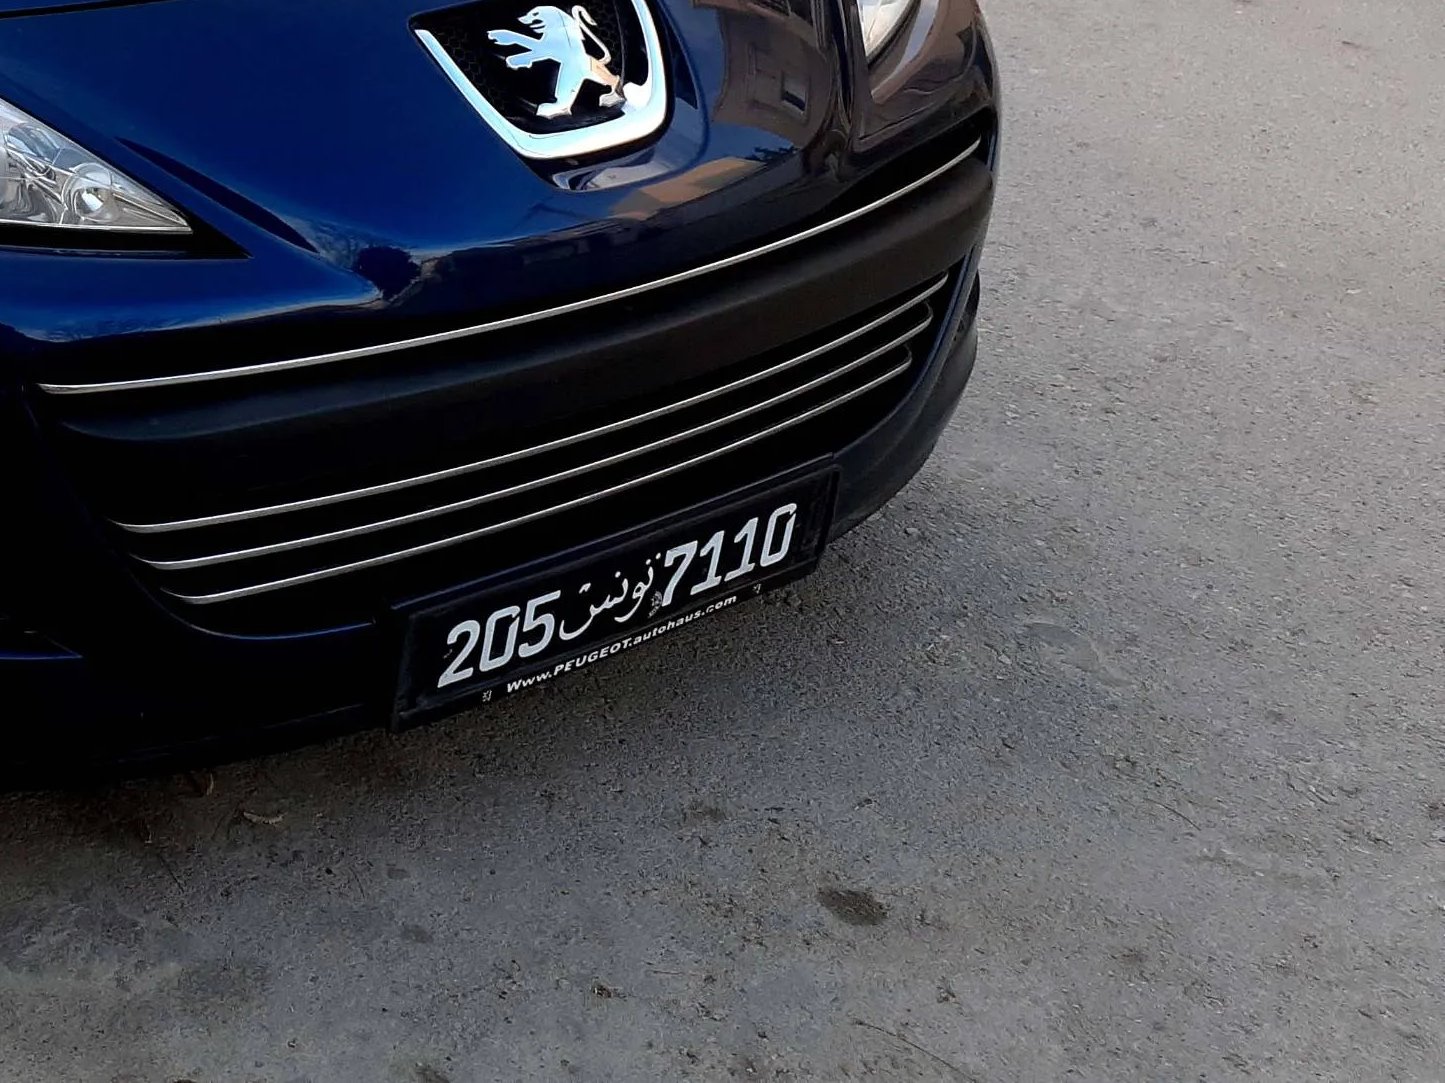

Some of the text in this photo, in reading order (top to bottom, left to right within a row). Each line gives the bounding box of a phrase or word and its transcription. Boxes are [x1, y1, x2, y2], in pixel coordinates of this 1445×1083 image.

[438, 503, 798, 688] 205 تونس 7110
